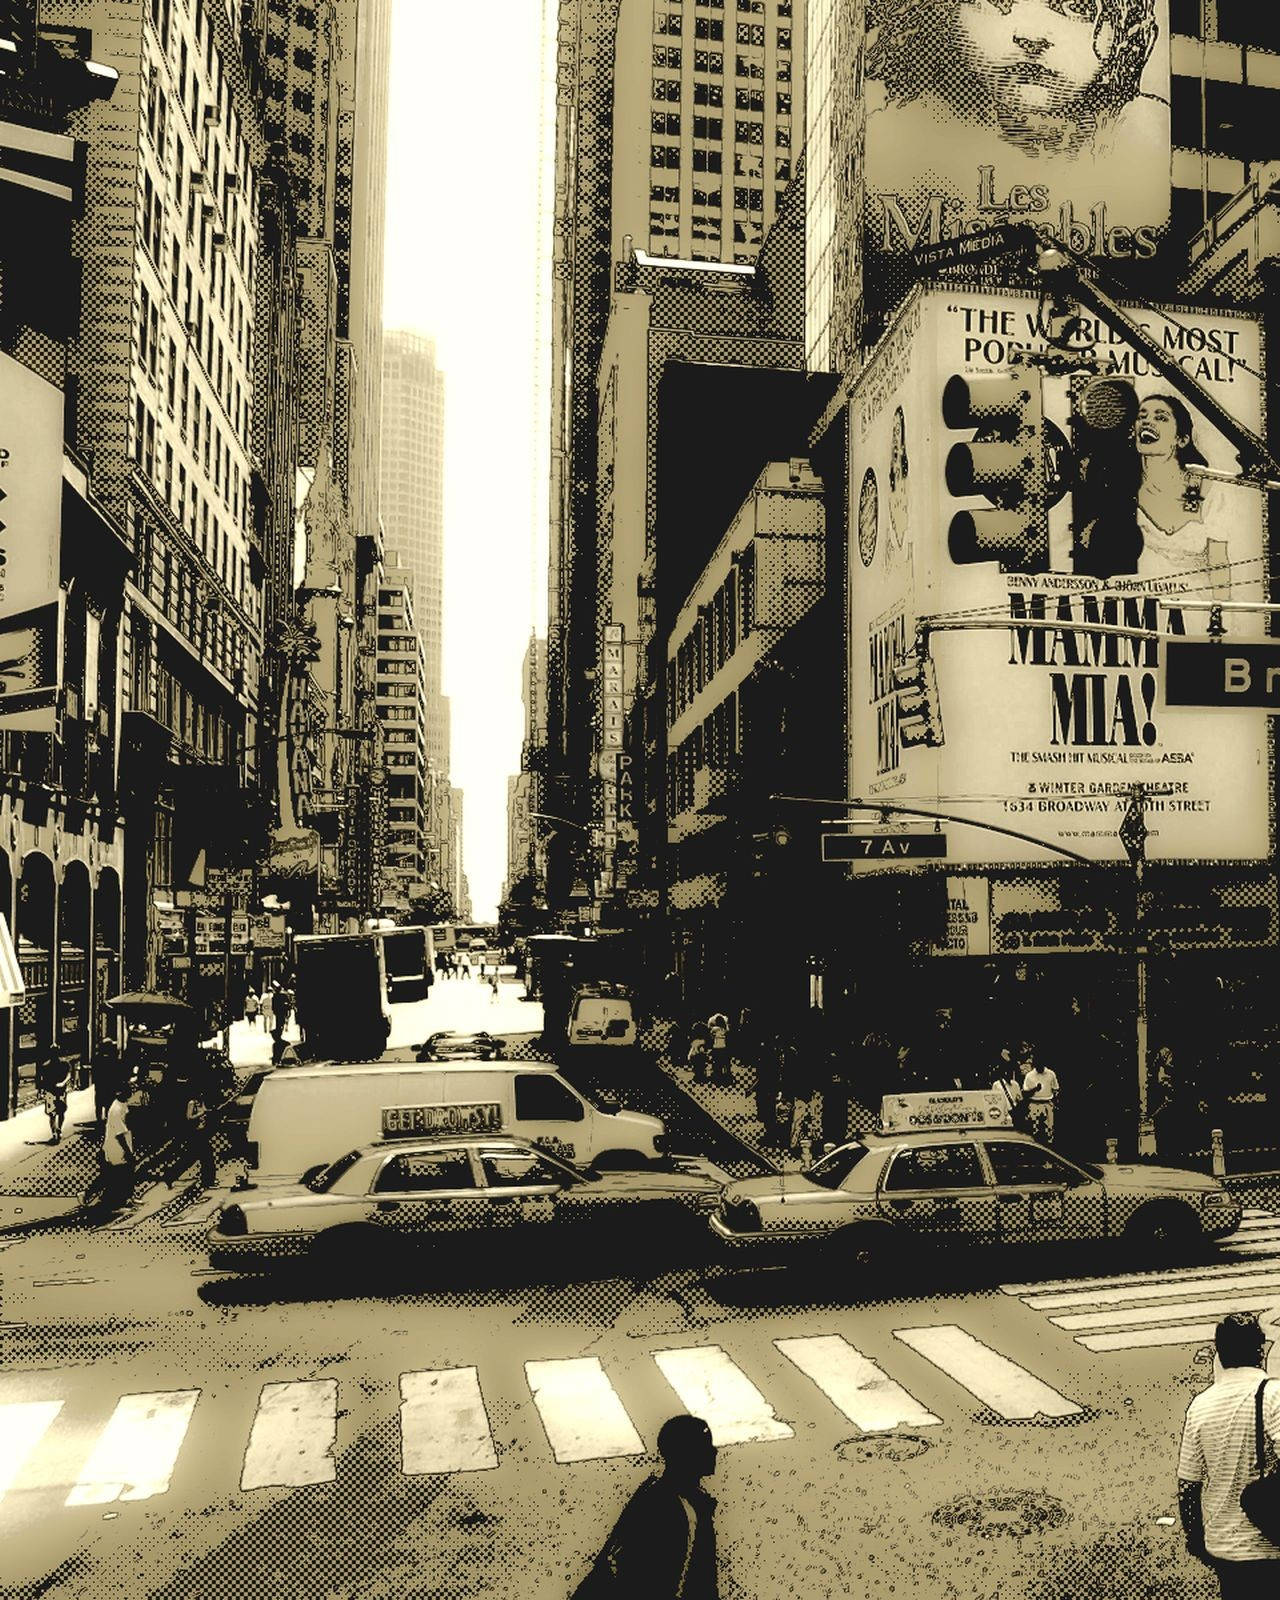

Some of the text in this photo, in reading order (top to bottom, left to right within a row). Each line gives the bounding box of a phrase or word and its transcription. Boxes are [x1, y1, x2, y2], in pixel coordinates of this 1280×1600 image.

[978, 165, 1050, 212] Les
[878, 194, 1158, 260] Miables
[914, 233, 1004, 266] VISTA MEDIA
[1164, 325, 1240, 353] MOST
[1049, 673, 1157, 746] MIA!
[620, 755, 633, 819] PARK
[1039, 783, 1085, 793] WINTER
[1038, 801, 1110, 812] BROADWAY
[1168, 801, 1211, 812] STREET
[862, 841, 911, 854] 7 Av
